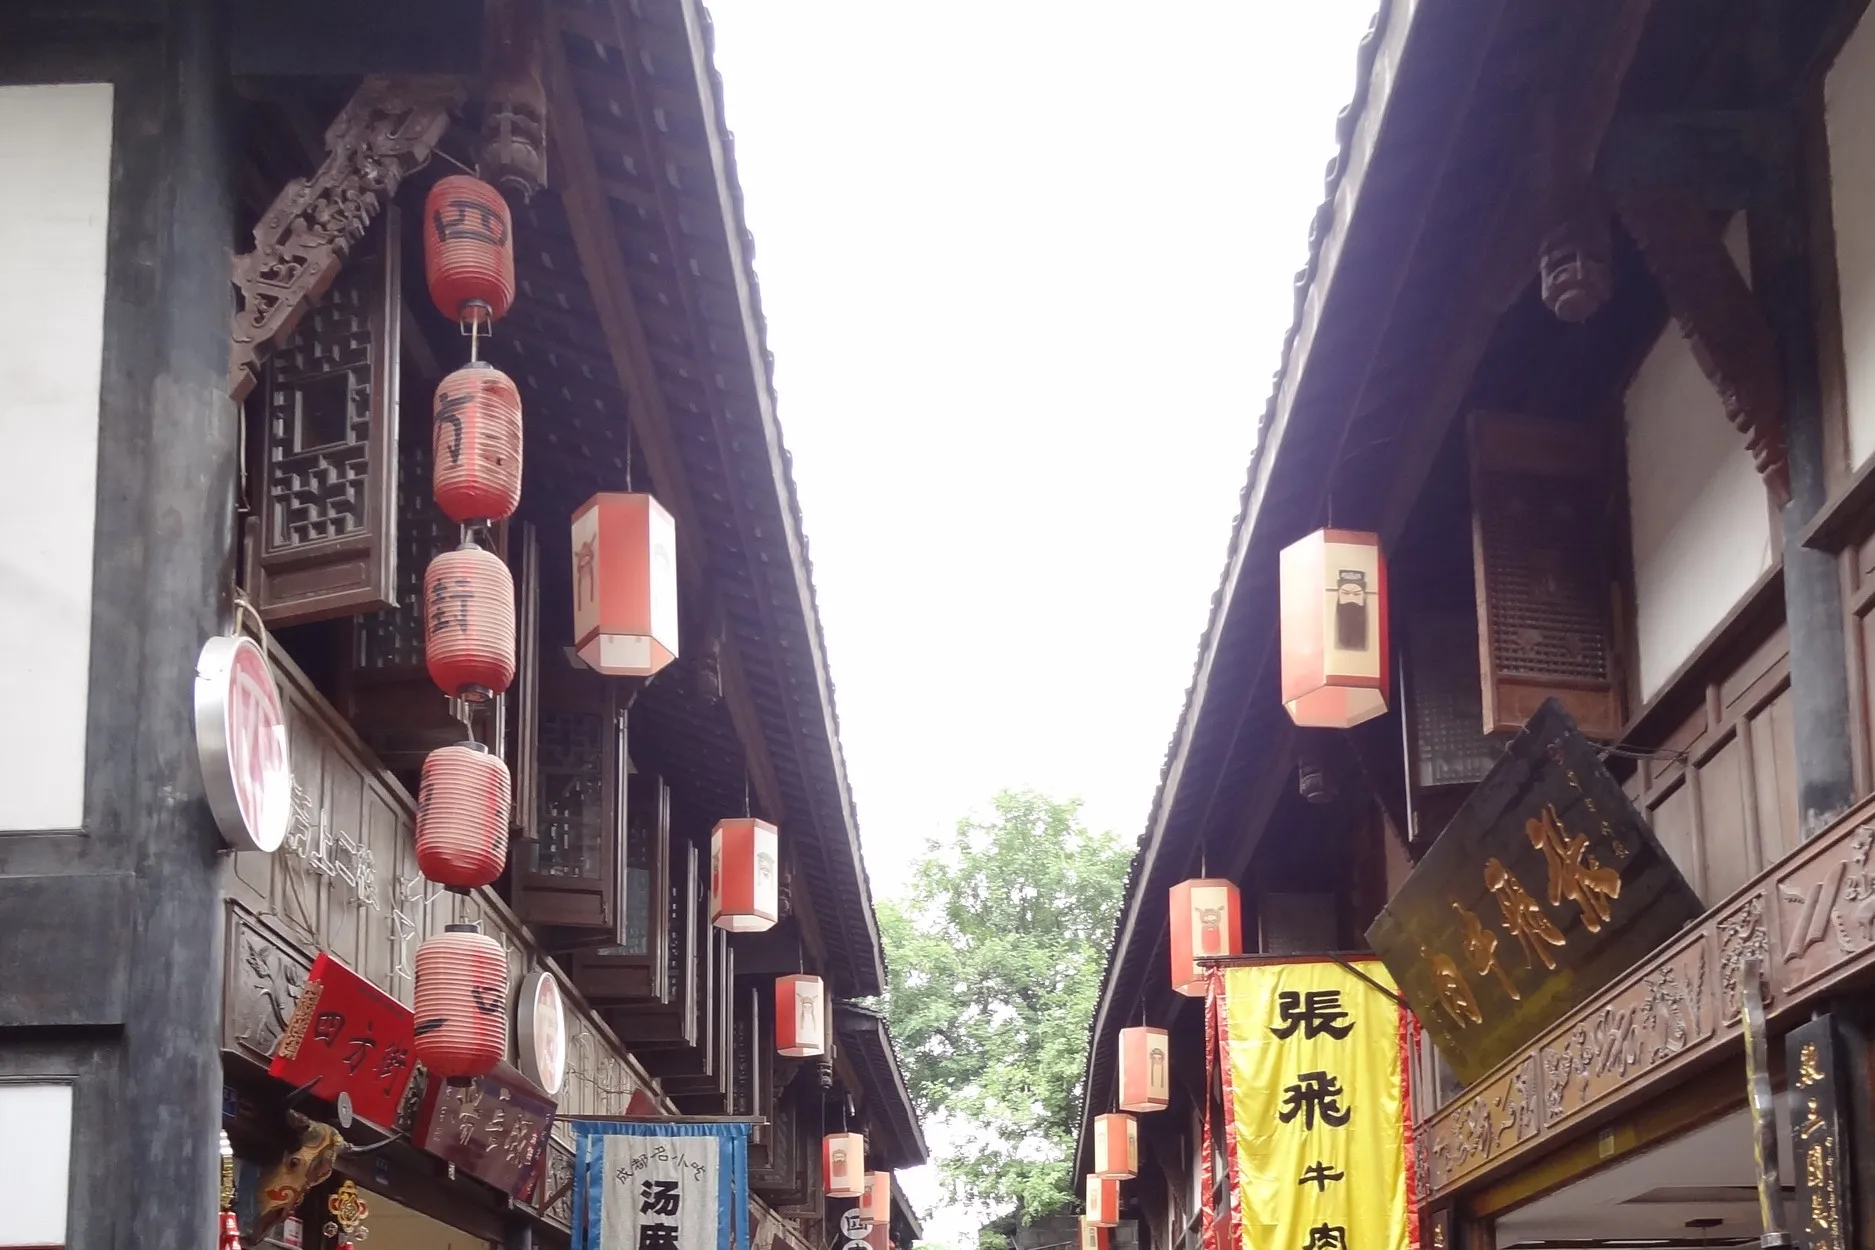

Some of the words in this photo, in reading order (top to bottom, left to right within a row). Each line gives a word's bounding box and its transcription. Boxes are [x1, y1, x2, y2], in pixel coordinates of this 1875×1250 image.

[313, 1010, 409, 1099] 四方街
[615, 1145, 707, 1186] 成都名小吃
